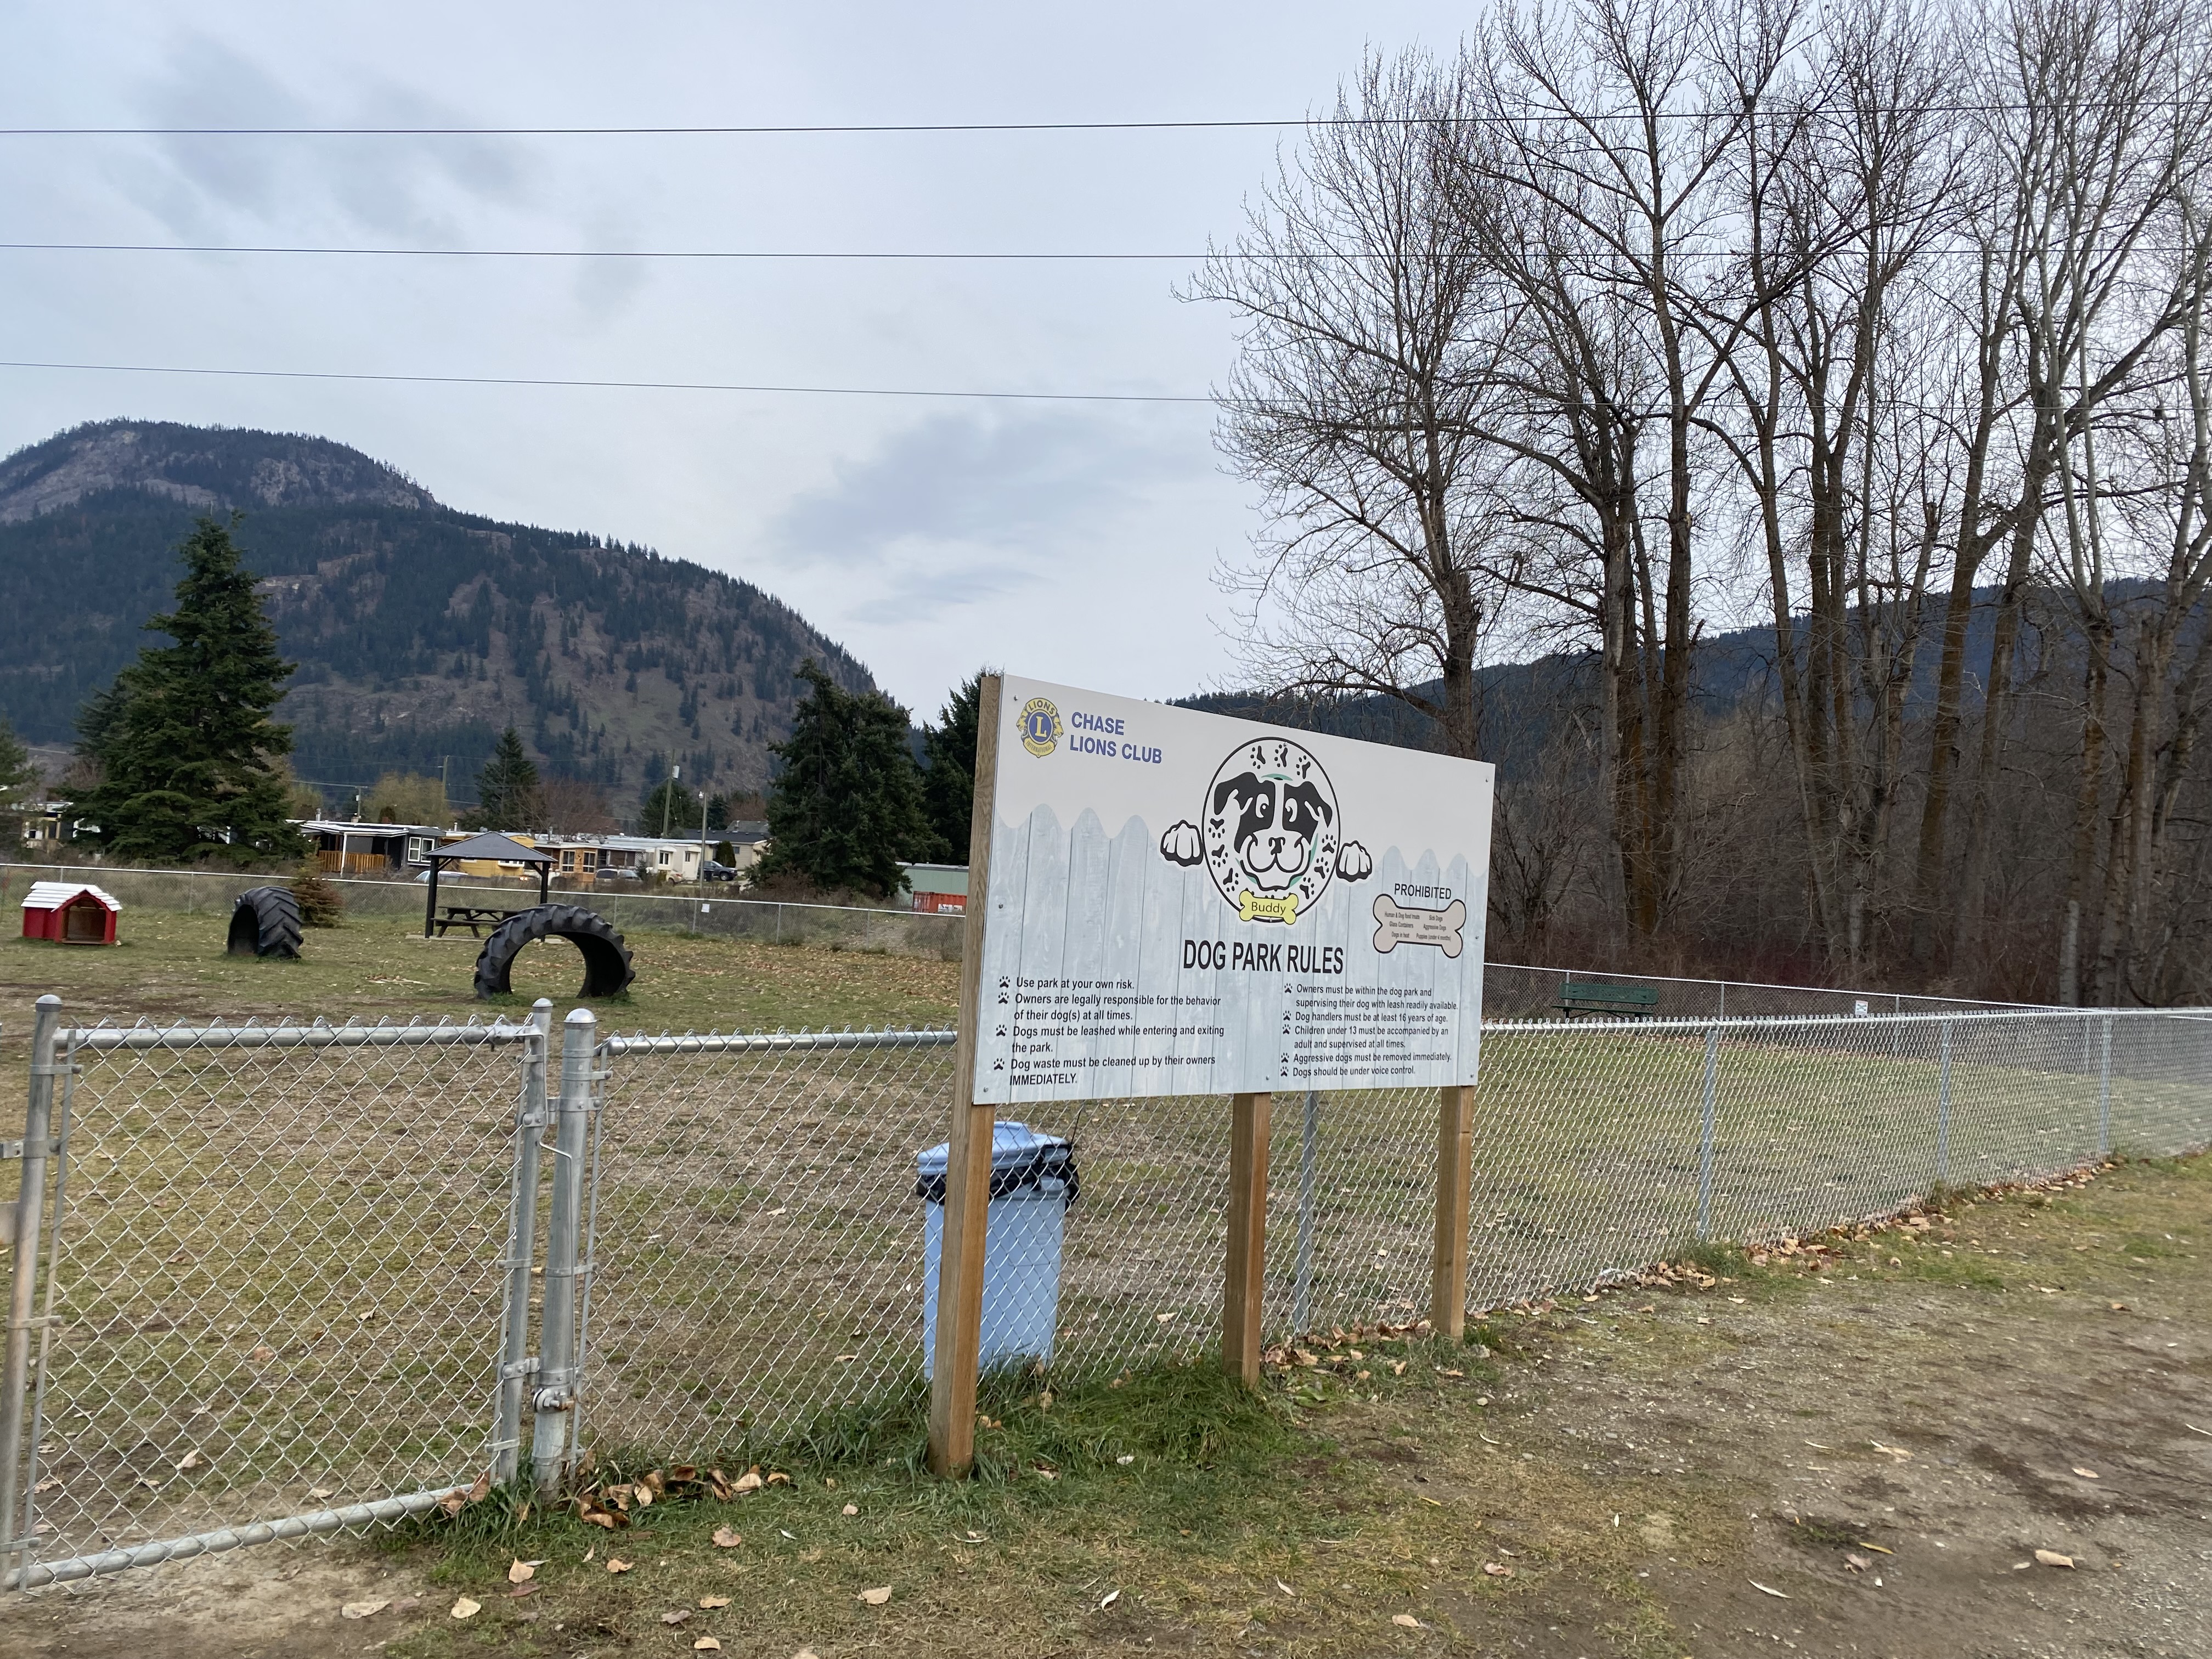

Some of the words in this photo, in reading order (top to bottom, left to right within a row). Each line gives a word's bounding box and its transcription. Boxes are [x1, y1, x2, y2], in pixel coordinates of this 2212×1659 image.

[1028, 700, 1055, 714] LIONS
[1035, 716, 1047, 737] L
[1071, 712, 1125, 735] CHASE
[1026, 741, 1052, 753] INTERNATIONAL
[1070, 735, 1116, 757] LIONS
[1122, 743, 1162, 764] CLUB
[1395, 883, 1452, 900] PROHIBITED
[1251, 902, 1286, 916] Buddy
[1183, 940, 1226, 970] DOG
[1232, 942, 1282, 972] PARK
[1287, 945, 1344, 974] RULES
[1017, 977, 1034, 988] Use
[1038, 978, 1058, 990] park
[1061, 979, 1070, 988] at
[1072, 980, 1093, 990] your
[1116, 979, 1135, 989] risk.
[1297, 984, 1323, 993] Owners
[1345, 985, 1353, 994] be
[1355, 986, 1375, 994] within
[1377, 986, 1387, 995] the
[1390, 987, 1402, 997] dog
[1404, 988, 1418, 997] park
[1015, 993, 1051, 1004] Owners
[1072, 994, 1101, 1007] legally
[1104, 995, 1154, 1007] responsible
[1156, 995, 1168, 1005] for
[1171, 996, 1183, 1005] the
[1186, 996, 1221, 1005] behavior
[1296, 998, 1337, 1009] supervising
[1340, 999, 1355, 1007] their
[1356, 1000, 1369, 1009] dog
[1372, 1000, 1385, 1008] with
[1387, 1000, 1404, 1008] leash
[1406, 1001, 1427, 1011] readily
[1014, 1009, 1024, 1020] of
[1026, 1009, 1048, 1020] their
[1051, 1009, 1080, 1023] dog(s)
[1083, 1011, 1091, 1019] at
[1094, 1009, 1104, 1019] all
[1107, 1011, 1132, 1019] times.
[1296, 1012, 1310, 1023] Dog
[1312, 1012, 1342, 1021] handlers
[1344, 1013, 1361, 1021] must
[1363, 1013, 1370, 1021] be
[1381, 1013, 1397, 1022] least
[1408, 1015, 1425, 1024] years
[1435, 1015, 1448, 1024] age.
[1013, 1026, 1037, 1039] Dogs
[1041, 1026, 1064, 1036] must
[1067, 1026, 1077, 1036] be
[1081, 1025, 1115, 1035] leashed
[1118, 1025, 1140, 1035] while
[1143, 1025, 1177, 1037] entering
[1180, 1025, 1195, 1035] and
[1197, 1026, 1224, 1037] exiting
[1295, 1025, 1324, 1035] Children
[1327, 1026, 1347, 1035] under
[1350, 1026, 1356, 1035] 13
[1358, 1026, 1375, 1035] must
[1377, 1026, 1385, 1035] be
[1387, 1027, 1430, 1036] accompanied
[1432, 1027, 1439, 1037] by
[1012, 1042, 1027, 1053] the
[1030, 1042, 1053, 1054] park.
[1294, 1040, 1312, 1049] adult
[1314, 1040, 1327, 1048] and
[1329, 1040, 1366, 1050] supervised
[1011, 1059, 1030, 1071] Dog
[1034, 1058, 1060, 1068] waste
[1063, 1058, 1086, 1068] must
[1089, 1057, 1099, 1067] be
[1103, 1056, 1136, 1066] cleaned
[1139, 1058, 1149, 1068] up
[1152, 1056, 1162, 1068] by
[1165, 1056, 1183, 1065] their
[1186, 1056, 1215, 1064] owners
[1294, 1053, 1333, 1064] Aggressive
[1335, 1053, 1352, 1064] dogs
[1373, 1053, 1381, 1061] be
[1383, 1052, 1411, 1061] removed
[1413, 1052, 1452, 1062] immediately.
[1009, 1073, 1077, 1085] IMMEDIATELY.
[1293, 1068, 1311, 1079] Dogs
[1313, 1067, 1338, 1076] should
[1340, 1067, 1347, 1075] be
[1350, 1066, 1369, 1075] under
[1372, 1066, 1389, 1074] voice
[1391, 1065, 1415, 1074] control.
